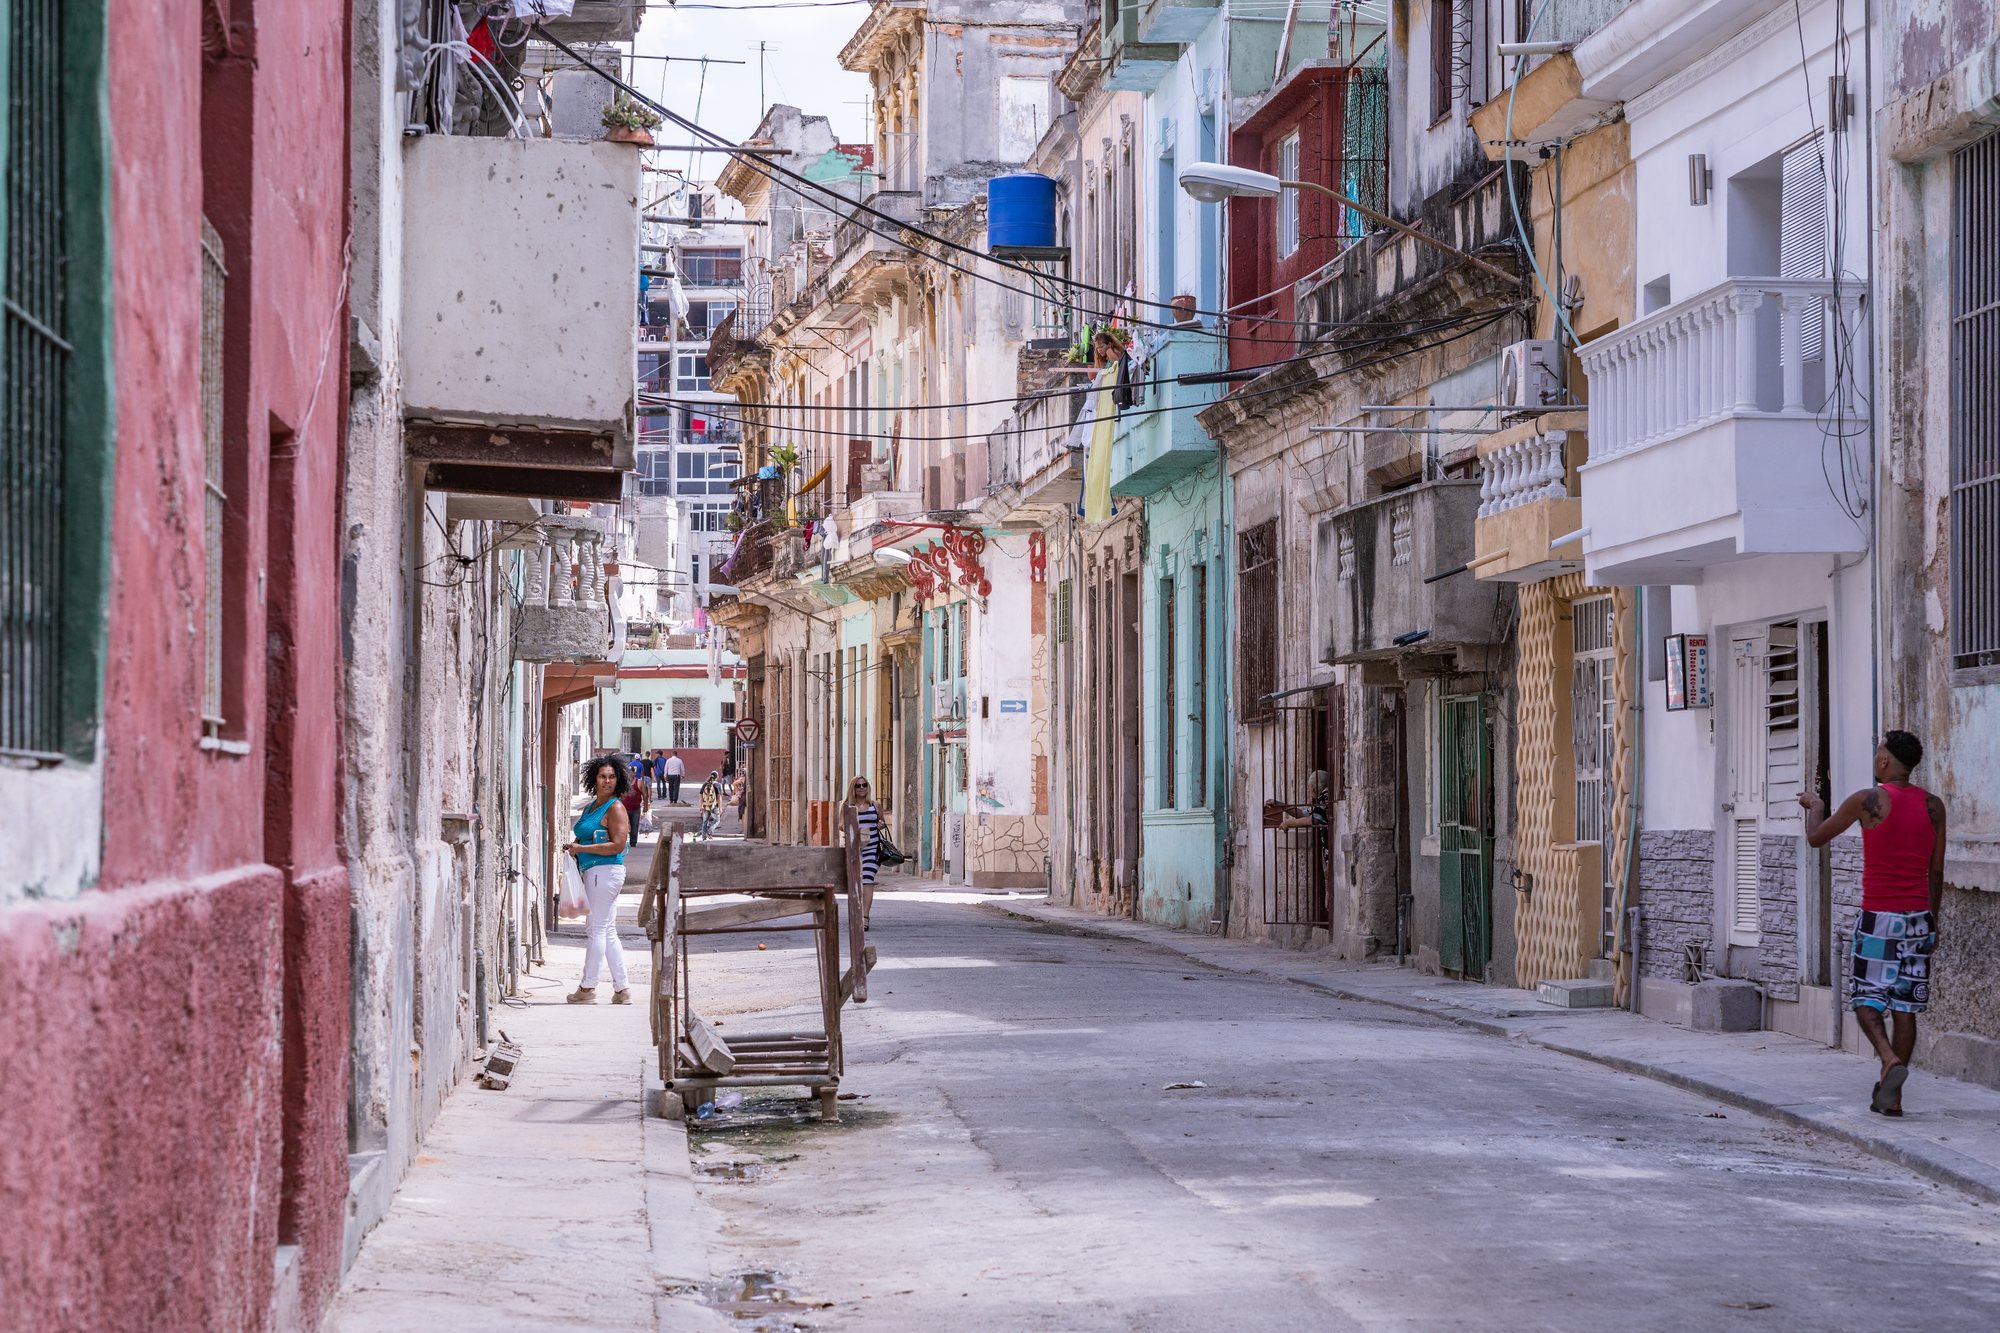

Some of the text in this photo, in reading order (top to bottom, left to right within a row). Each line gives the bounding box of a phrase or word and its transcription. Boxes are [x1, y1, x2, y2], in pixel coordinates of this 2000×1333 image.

[1689, 639, 1706, 647] RENTA
[1689, 649, 1697, 704] MONEDA NACIONAL
[1699, 649, 1707, 704] DIVISA
